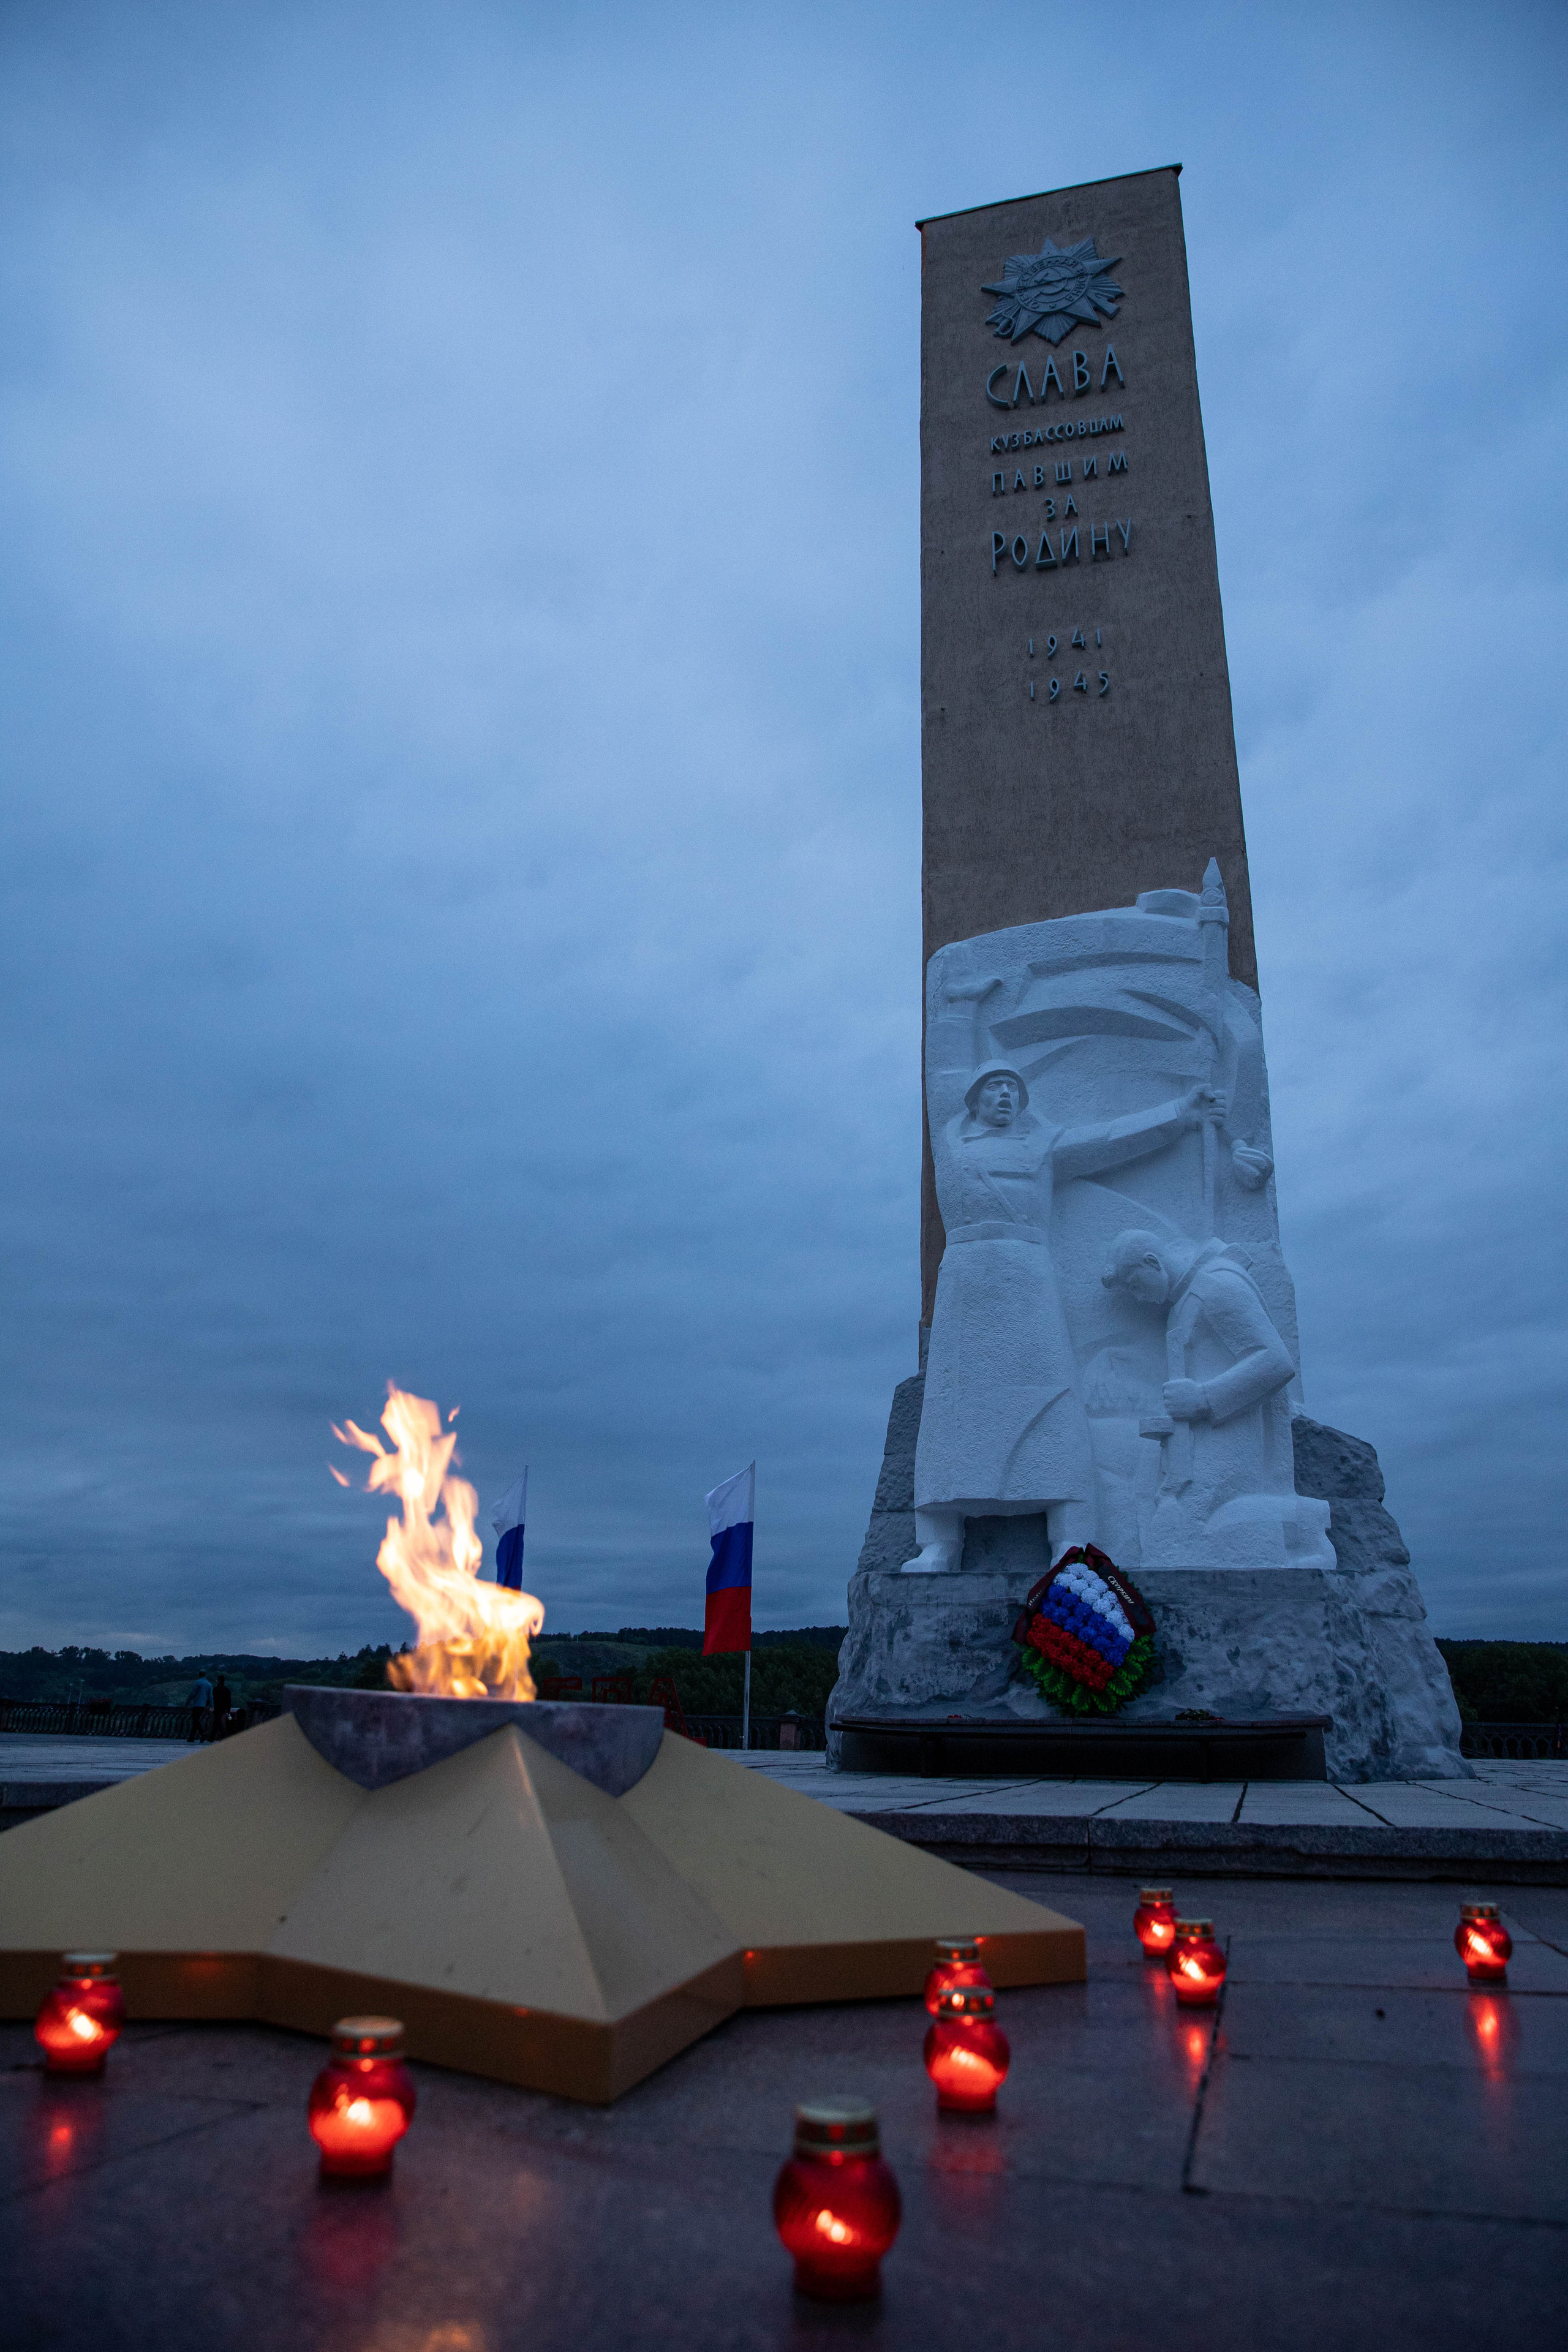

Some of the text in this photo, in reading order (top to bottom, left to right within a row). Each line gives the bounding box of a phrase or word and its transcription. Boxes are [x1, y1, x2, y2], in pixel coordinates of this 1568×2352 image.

[986, 344, 1125, 408] СЛАВА
[990, 413, 1125, 453] КУЗБАССОВЦАМ
[992, 450, 1128, 495] ПАВШИМ
[1045, 493, 1078, 521] ЗА
[992, 518, 1131, 576] РОДИНУ
[1029, 628, 1101, 658] 1941
[1030, 671, 1109, 702] 1945
[1107, 1575, 1134, 1604] СКОРБИМ
